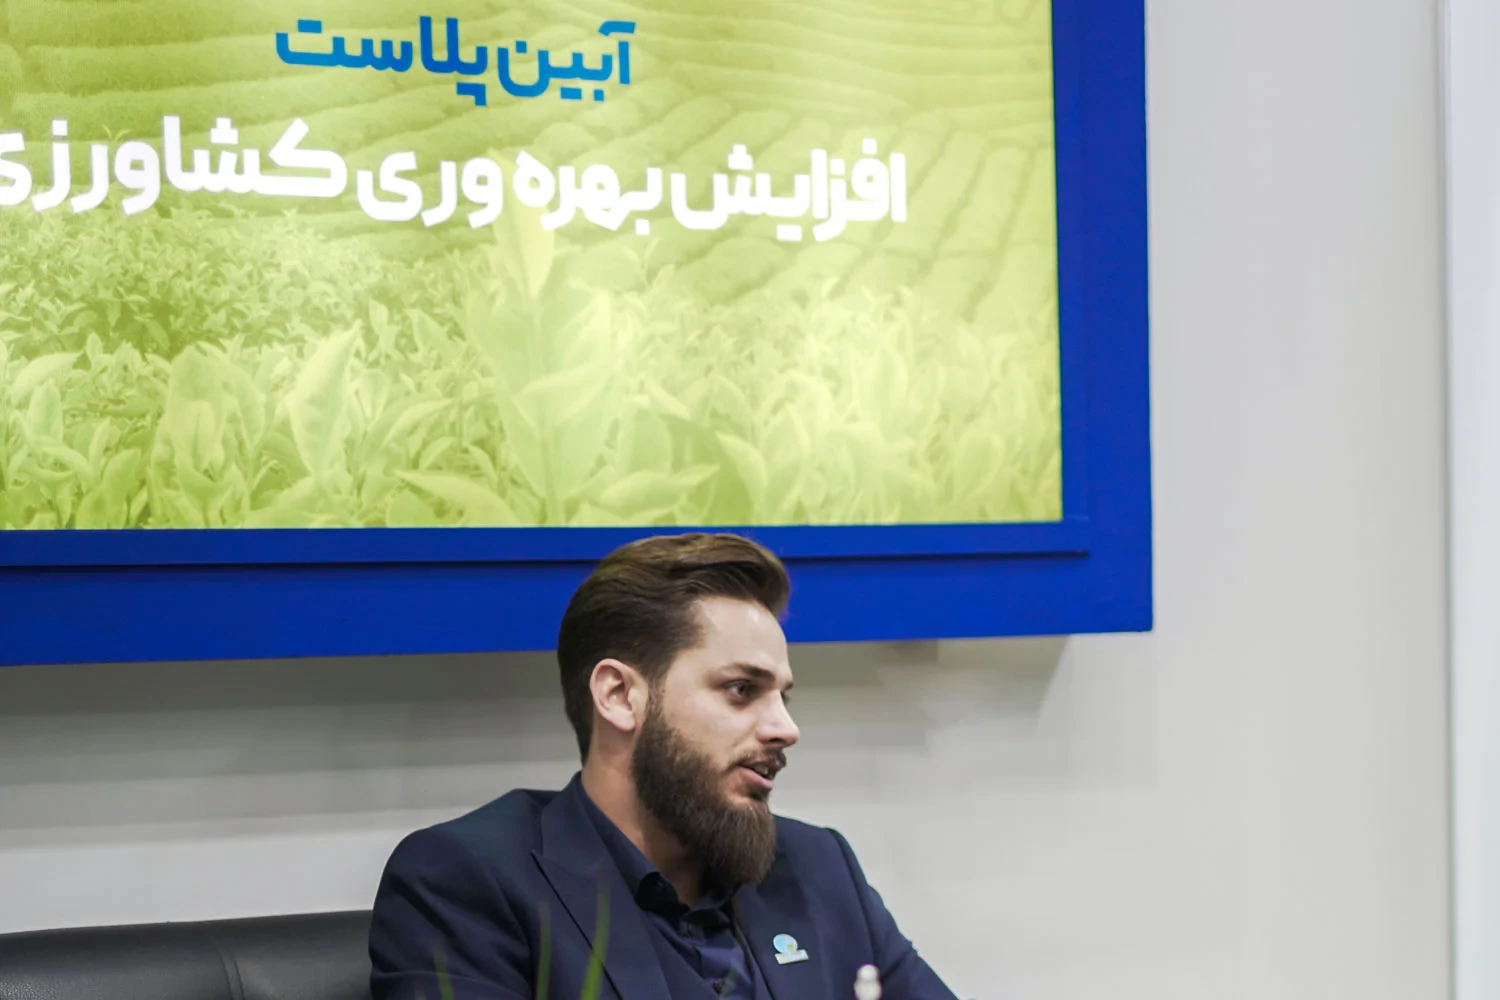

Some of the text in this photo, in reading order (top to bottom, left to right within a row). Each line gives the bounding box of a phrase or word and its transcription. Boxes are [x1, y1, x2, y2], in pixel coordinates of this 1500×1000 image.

[276, 16, 637, 106] آبین پلاست
[671, 138, 907, 242] افزایش
